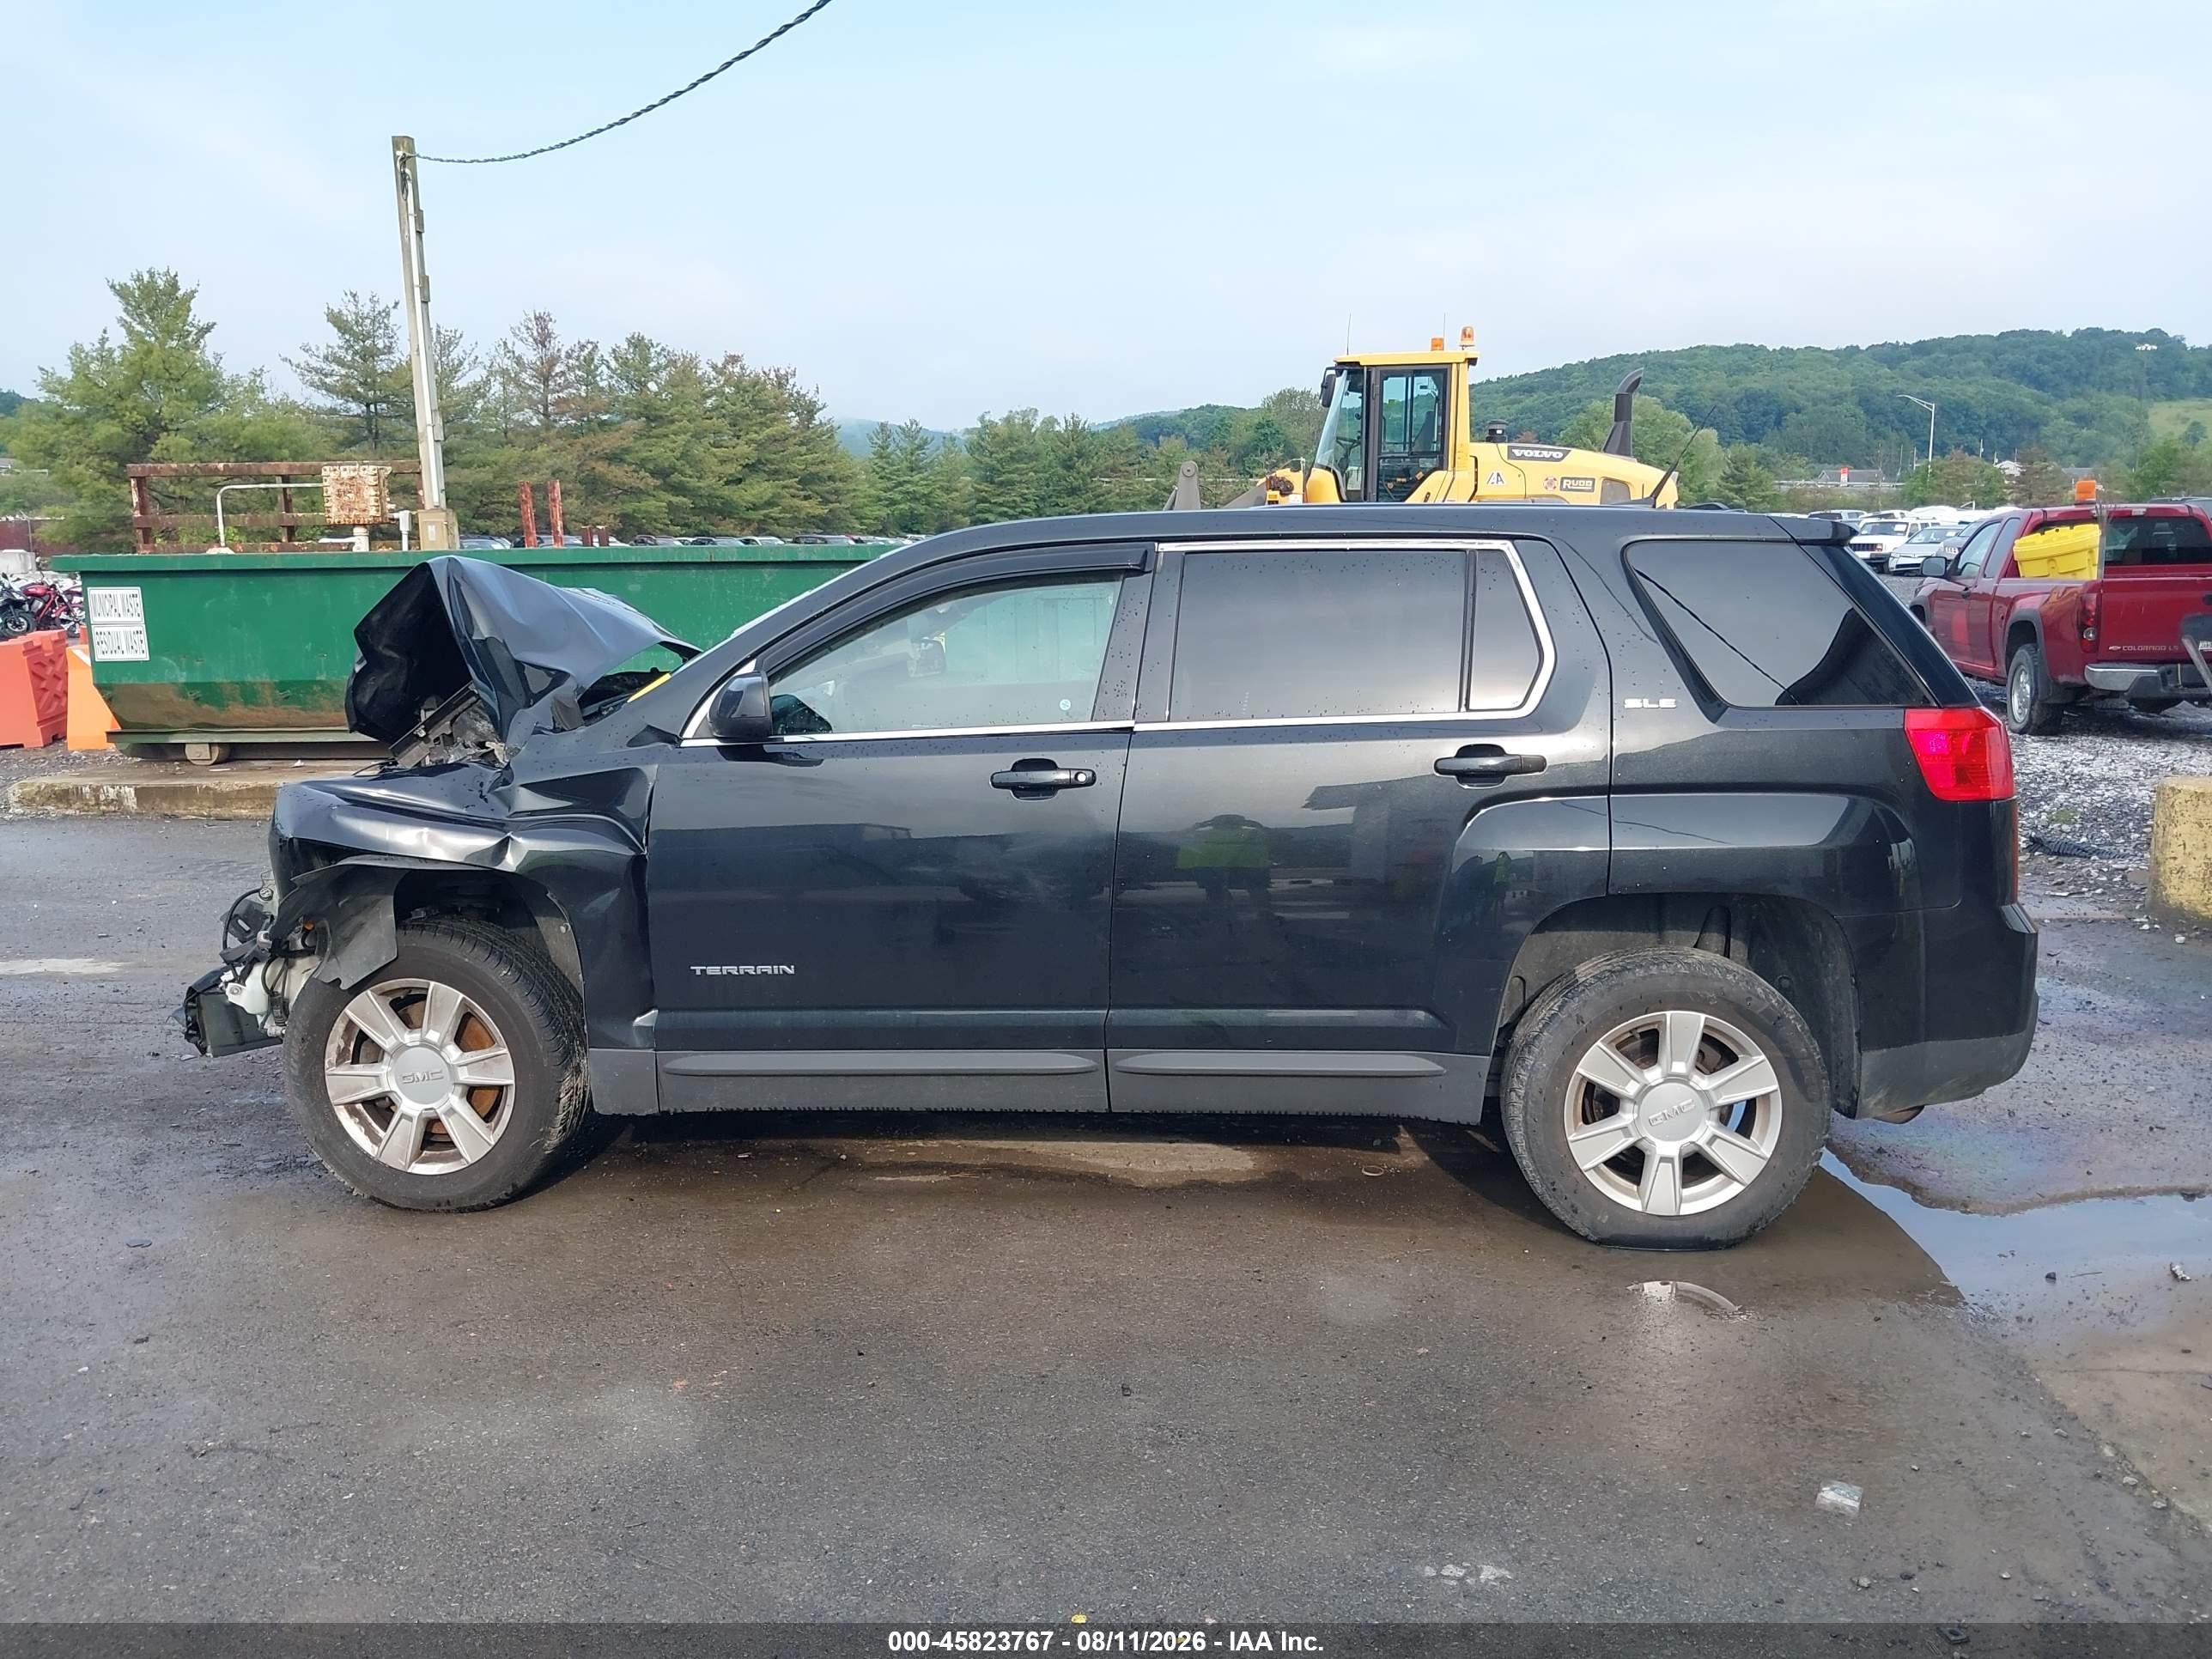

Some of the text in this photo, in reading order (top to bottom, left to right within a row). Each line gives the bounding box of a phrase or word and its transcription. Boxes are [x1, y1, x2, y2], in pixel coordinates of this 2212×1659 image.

[1511, 448, 1564, 459] VOLVO
[90, 592, 141, 617] MUNICIPAL WASTE
[95, 629, 145, 655] RESIDUAL WASTE
[1624, 698, 1677, 708] SLE
[690, 965, 795, 975] TERRAIN
[399, 1070, 444, 1085] GMC
[1648, 1098, 1696, 1127] GMC
